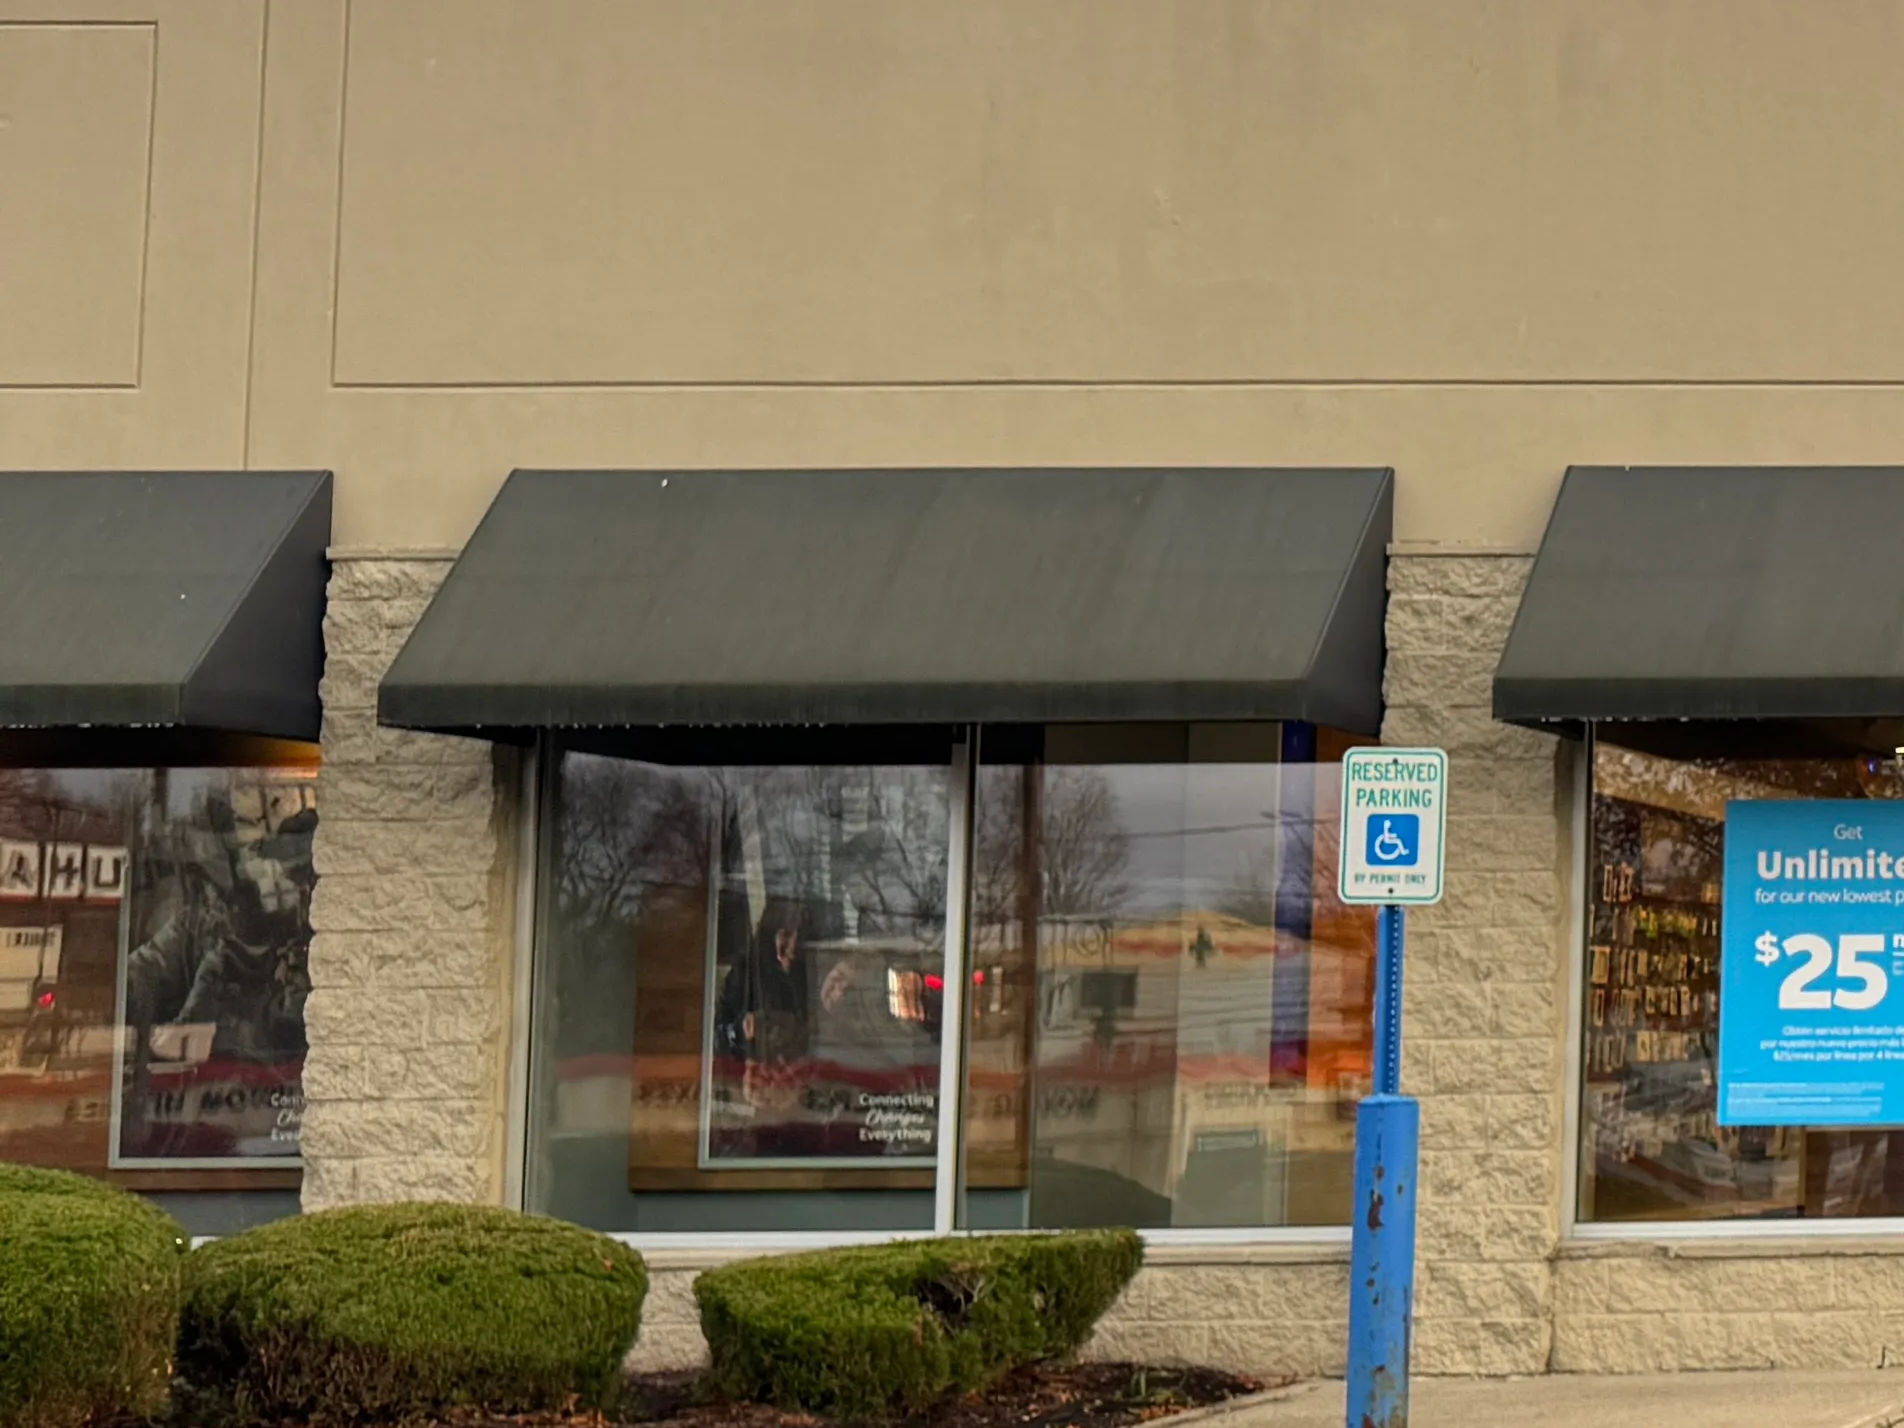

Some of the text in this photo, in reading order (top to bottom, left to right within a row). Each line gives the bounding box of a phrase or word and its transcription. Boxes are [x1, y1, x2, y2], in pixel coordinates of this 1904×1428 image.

[1352, 761, 1438, 782] RESERVED
[1356, 788, 1432, 808] PARKING
[1833, 824, 1863, 840] Get
[1354, 873, 1427, 885] BY PERMIT ONLY
[1755, 888, 1776, 904] for
[1780, 890, 1805, 903] our
[1808, 890, 1840, 903] new
[1843, 888, 1892, 904] lowest
[1755, 930, 1888, 1010] $25
[859, 1092, 934, 1109] Connecting
[859, 1126, 932, 1143] Everything
